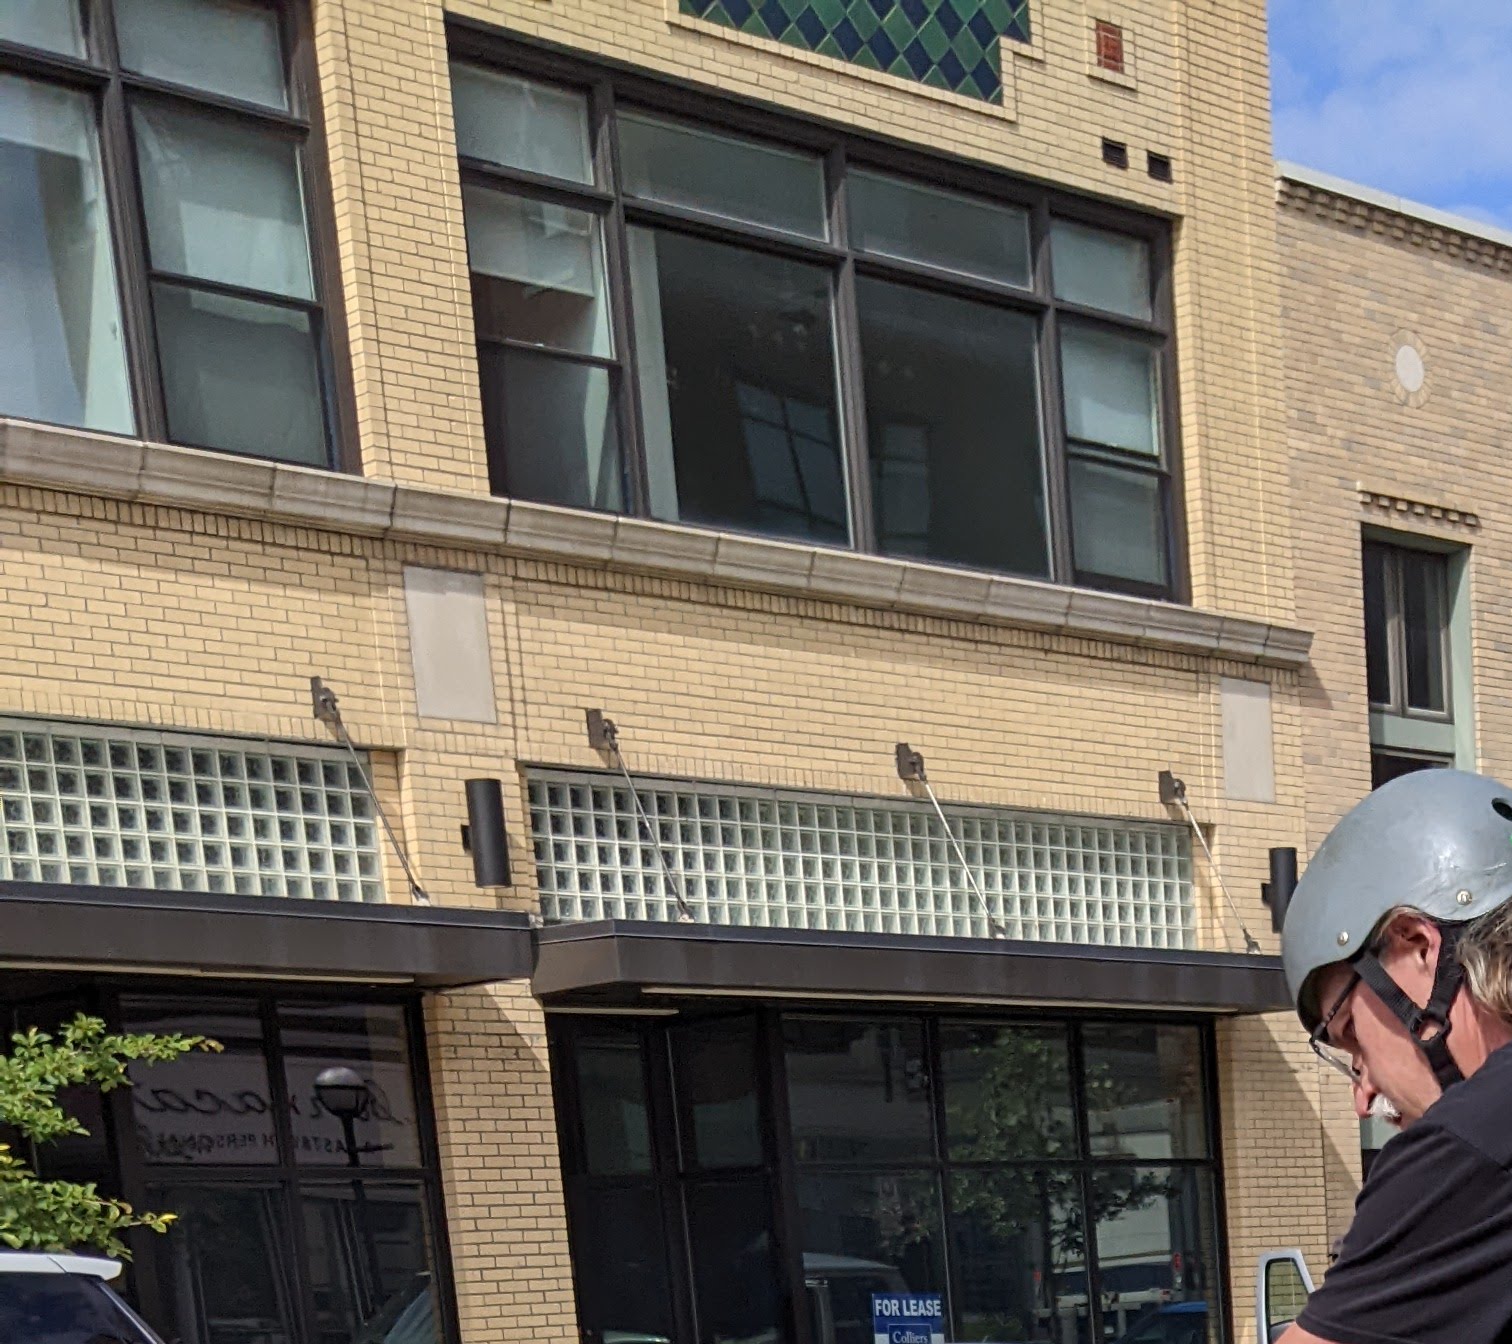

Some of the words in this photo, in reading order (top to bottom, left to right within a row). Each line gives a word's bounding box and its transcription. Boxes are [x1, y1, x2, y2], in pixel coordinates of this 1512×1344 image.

[875, 1300, 900, 1316] FOR
[902, 1300, 942, 1316] LEASE
[892, 1331, 928, 1344] Colliers
